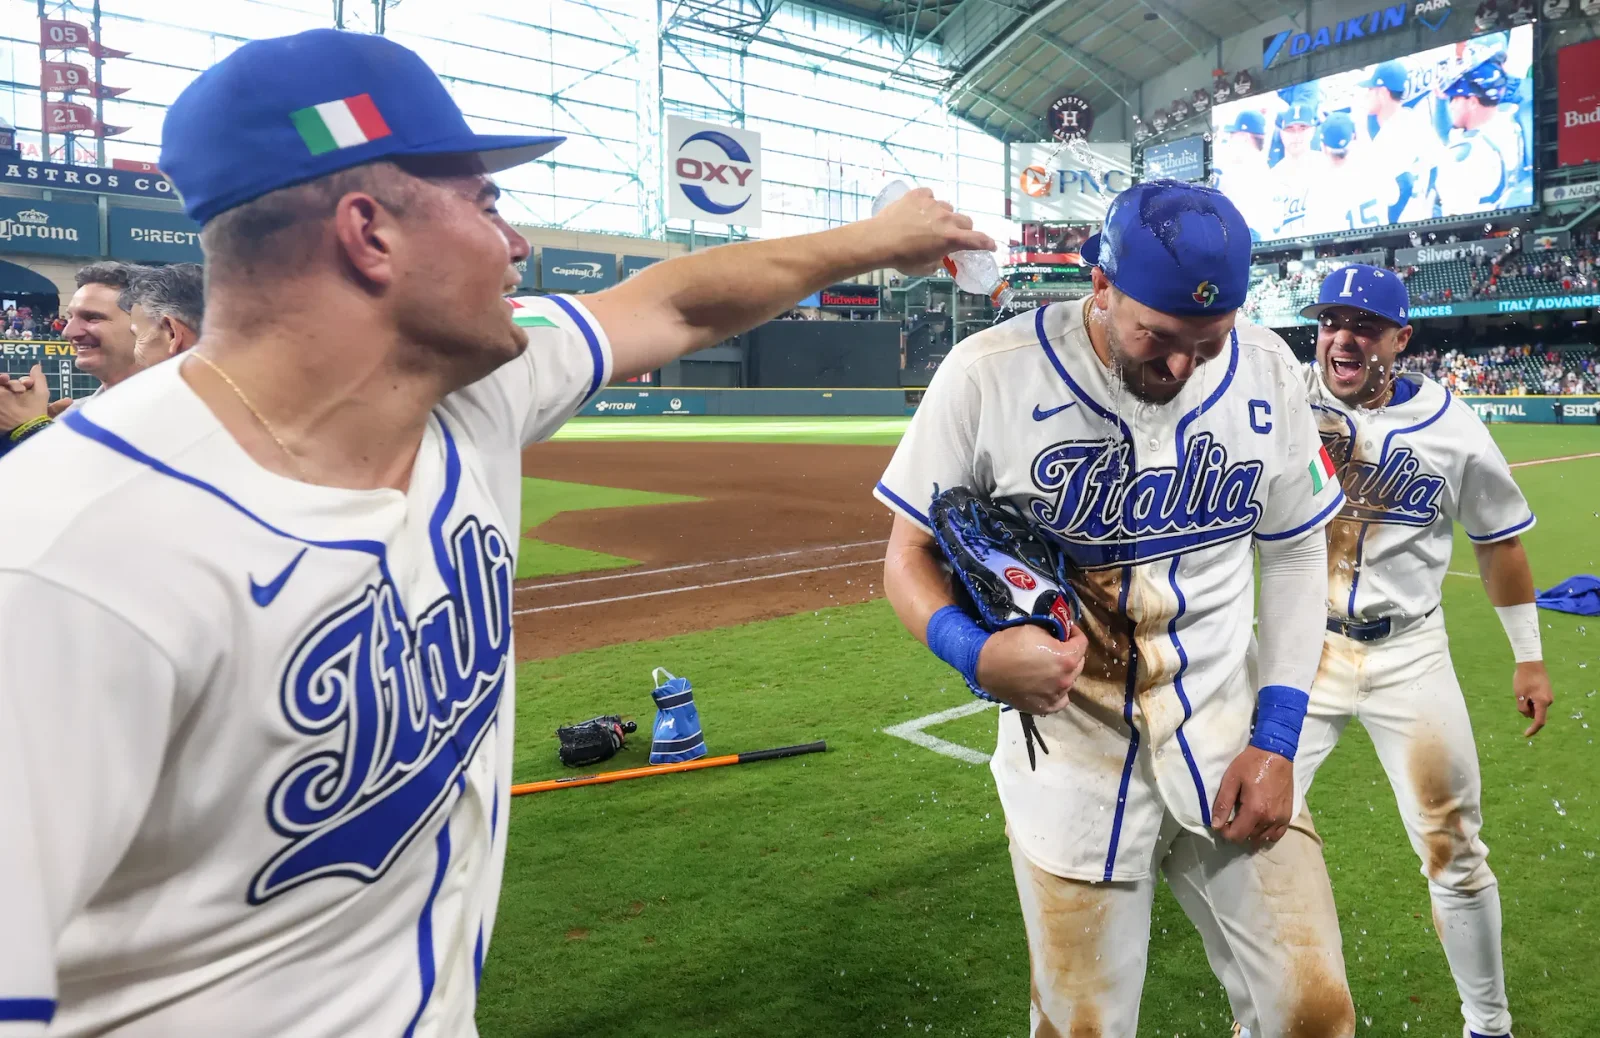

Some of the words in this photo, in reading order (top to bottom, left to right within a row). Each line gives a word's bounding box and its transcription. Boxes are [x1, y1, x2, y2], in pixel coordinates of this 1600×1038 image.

[1415, 0, 1451, 15] PARK
[49, 26, 78, 43] 05
[1289, 4, 1407, 56] DAIKIN
[53, 69, 80, 85] 19
[1052, 96, 1089, 110] HOUSTON
[53, 109, 78, 123] 21
[1061, 110, 1079, 127] H
[1564, 106, 1600, 128] Bud
[1053, 127, 1087, 140] ASTROS
[5, 164, 119, 187] ASTROS
[134, 178, 171, 193] CO
[676, 157, 753, 187] OXY
[1057, 168, 1127, 195] PNC
[0, 217, 79, 241] Corona
[1339, 268, 1358, 298] I
[822, 292, 879, 305] Budweiser
[1499, 299, 1533, 312] ITALY
[1248, 399, 1273, 435] C
[1030, 431, 1264, 545] Italia
